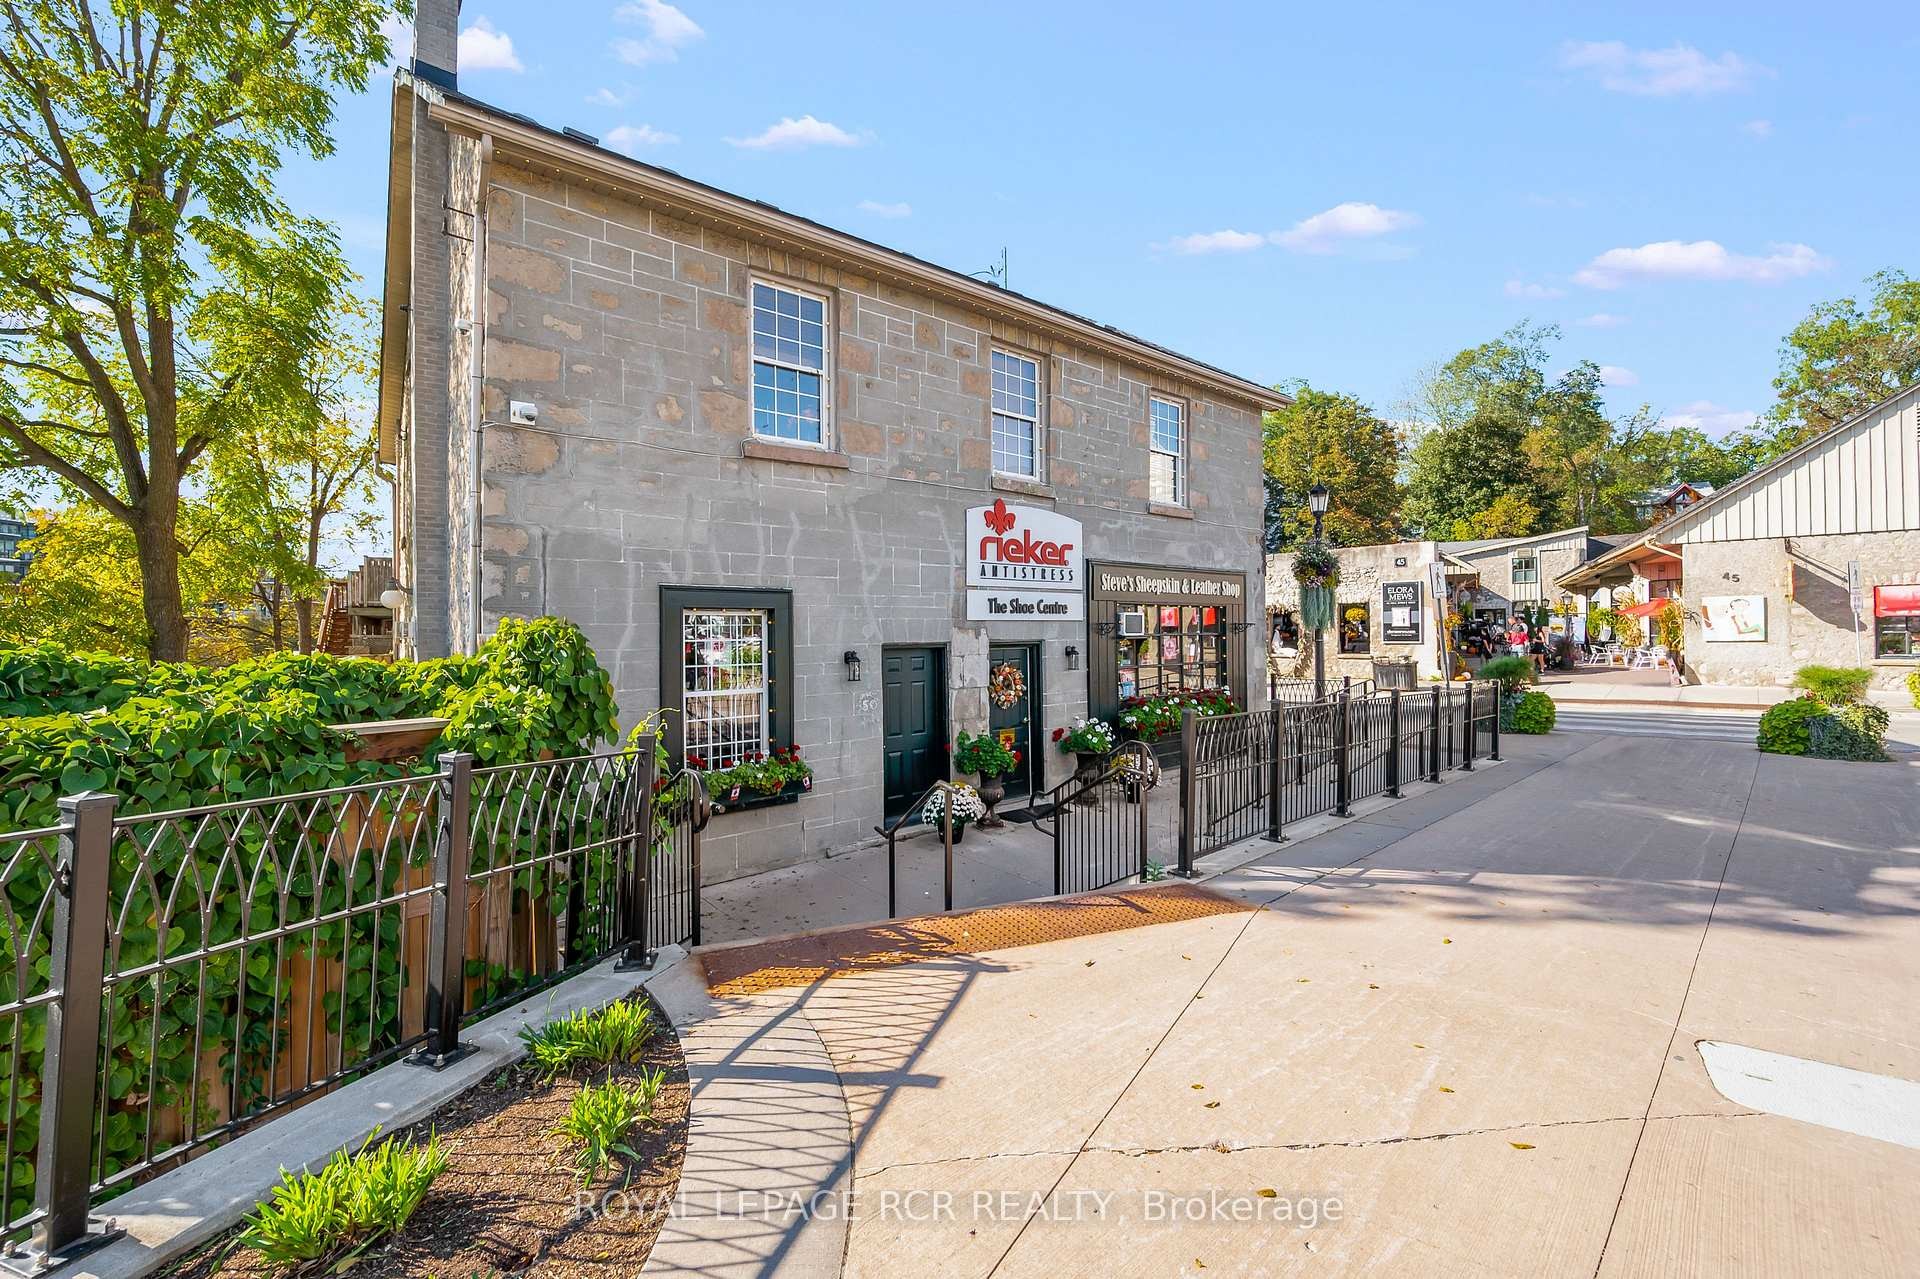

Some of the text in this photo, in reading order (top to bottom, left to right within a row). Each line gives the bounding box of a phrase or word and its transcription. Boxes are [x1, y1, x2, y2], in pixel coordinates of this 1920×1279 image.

[980, 529, 1073, 566] rieker
[980, 565, 1073, 580] ANTISTRESS
[1722, 572, 1740, 583] 45
[1101, 573, 1240, 598] Steve's Sheepskin & Leather Shop
[1387, 586, 1414, 594] ELORA
[988, 597, 1068, 614] The Shoe Centre
